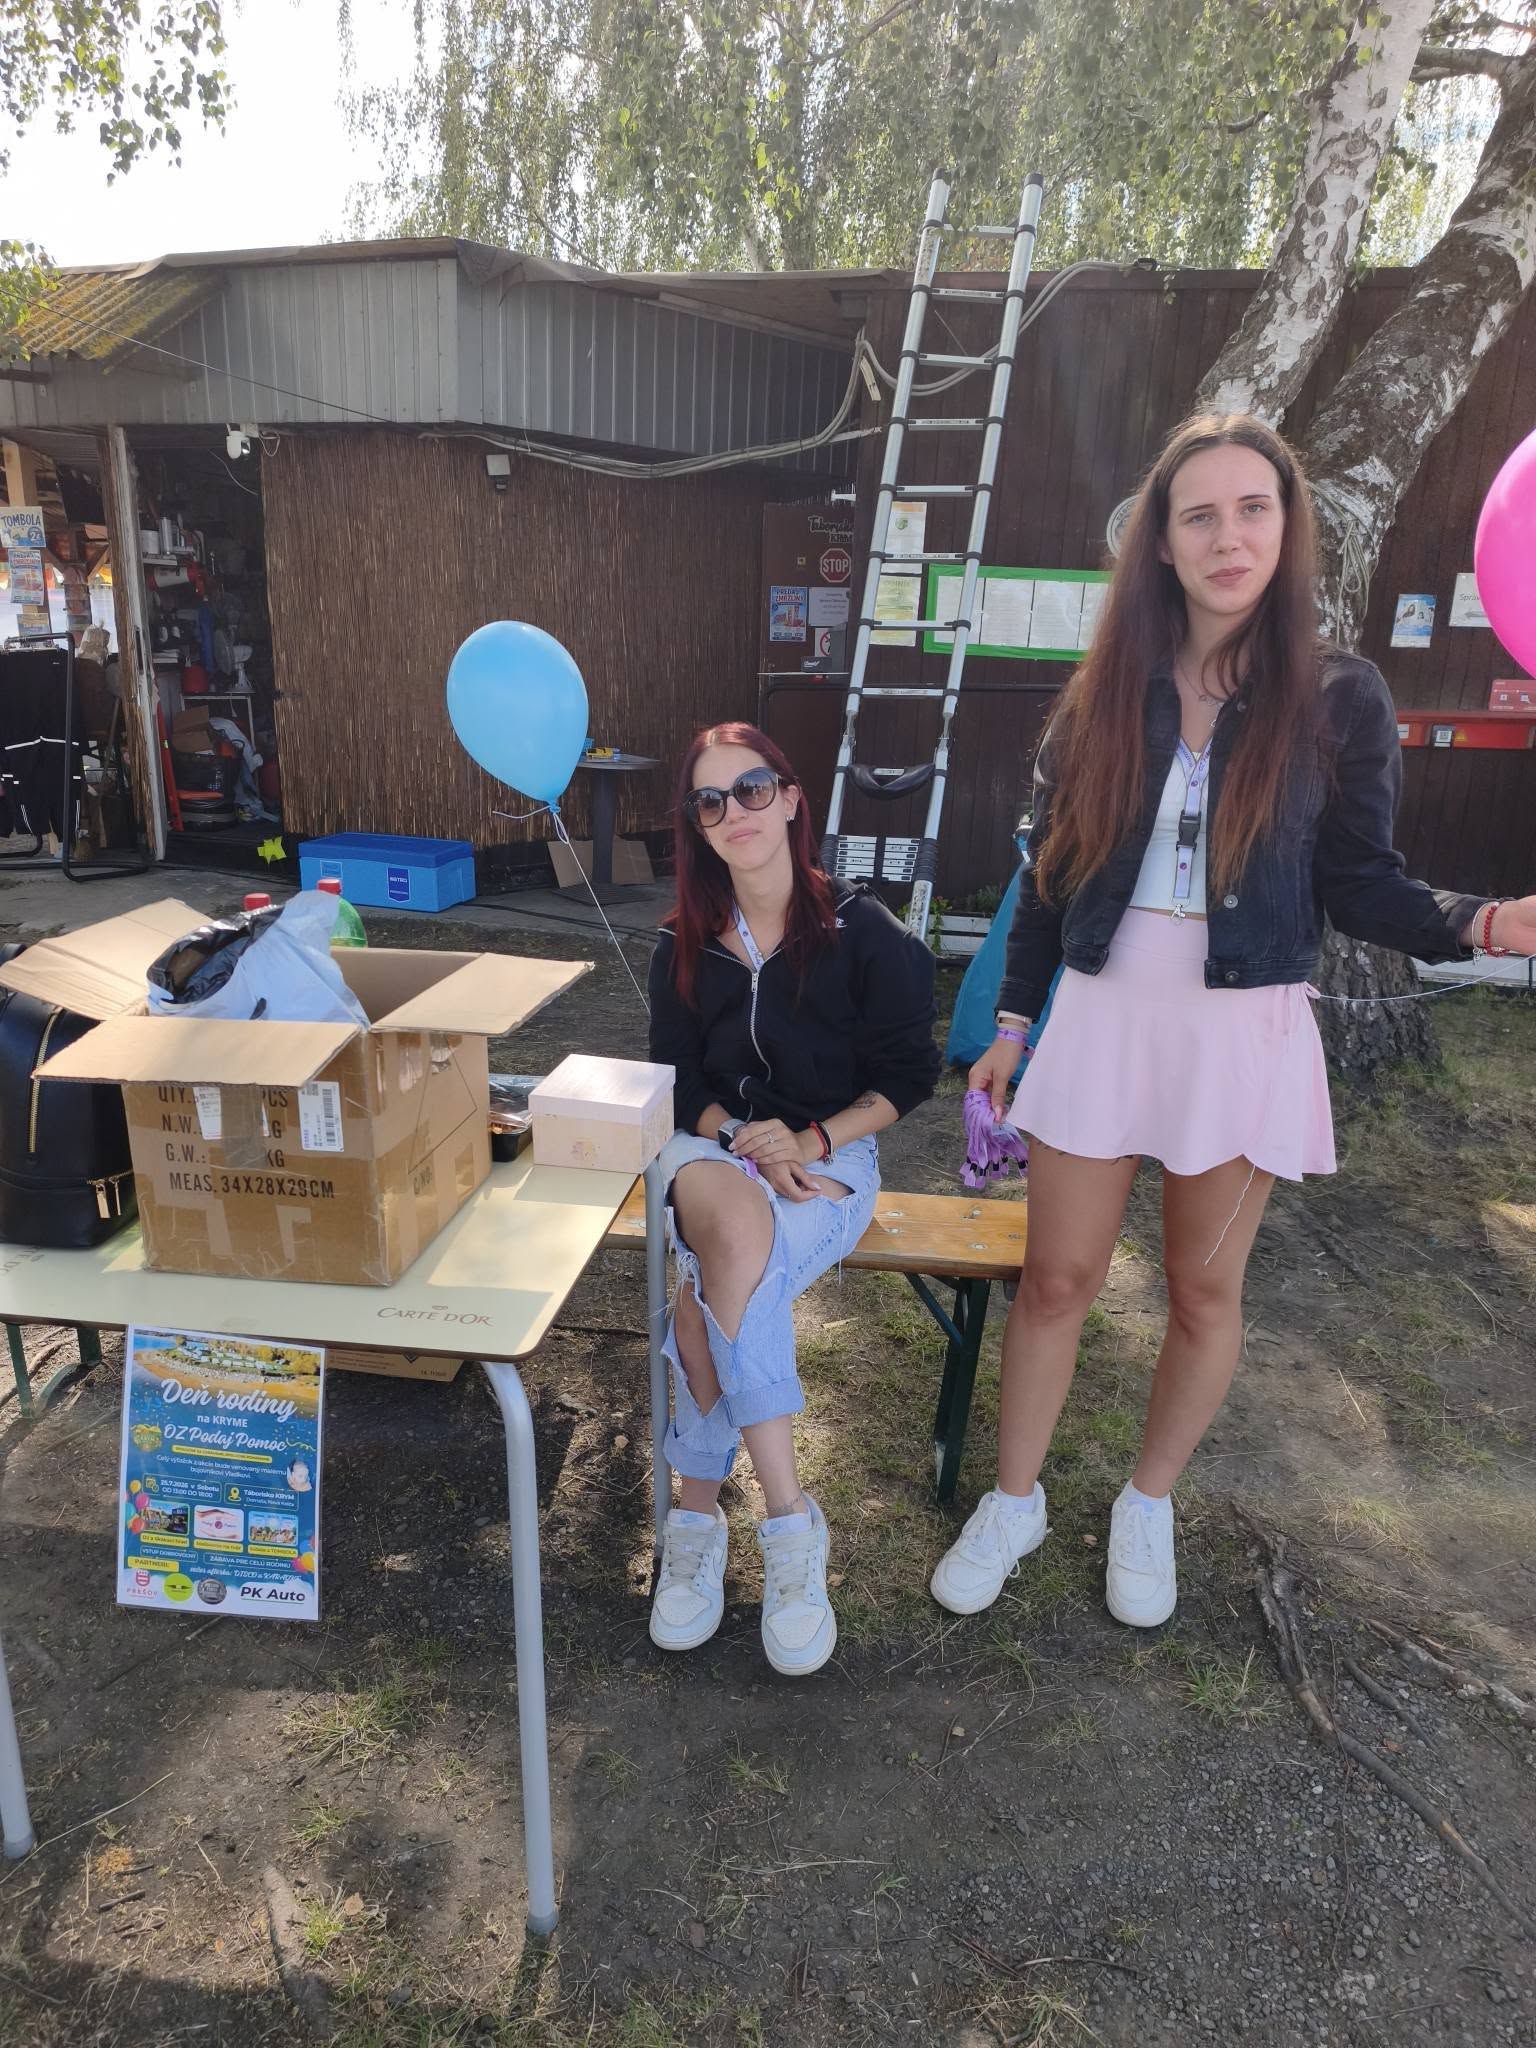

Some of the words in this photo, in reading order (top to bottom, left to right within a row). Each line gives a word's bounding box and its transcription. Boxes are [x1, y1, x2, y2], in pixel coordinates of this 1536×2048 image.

[1, 513, 41, 528] TOMBOLA
[822, 558, 849, 573] STOP
[169, 1172, 217, 1193] MEAS.
[377, 1307, 440, 1320] CARTE
[444, 1313, 494, 1327] D'OR
[161, 1378, 212, 1405] Deň
[216, 1389, 298, 1423] rodiny
[197, 1414, 210, 1423] na
[213, 1415, 249, 1428] KRYME
[164, 1424, 189, 1440] OZ
[189, 1427, 235, 1450] Podaj
[236, 1432, 288, 1452] Pomoc
[210, 1555, 235, 1564] ZÁBAVA
[240, 1586, 262, 1599] PK
[267, 1588, 306, 1602] Auto
